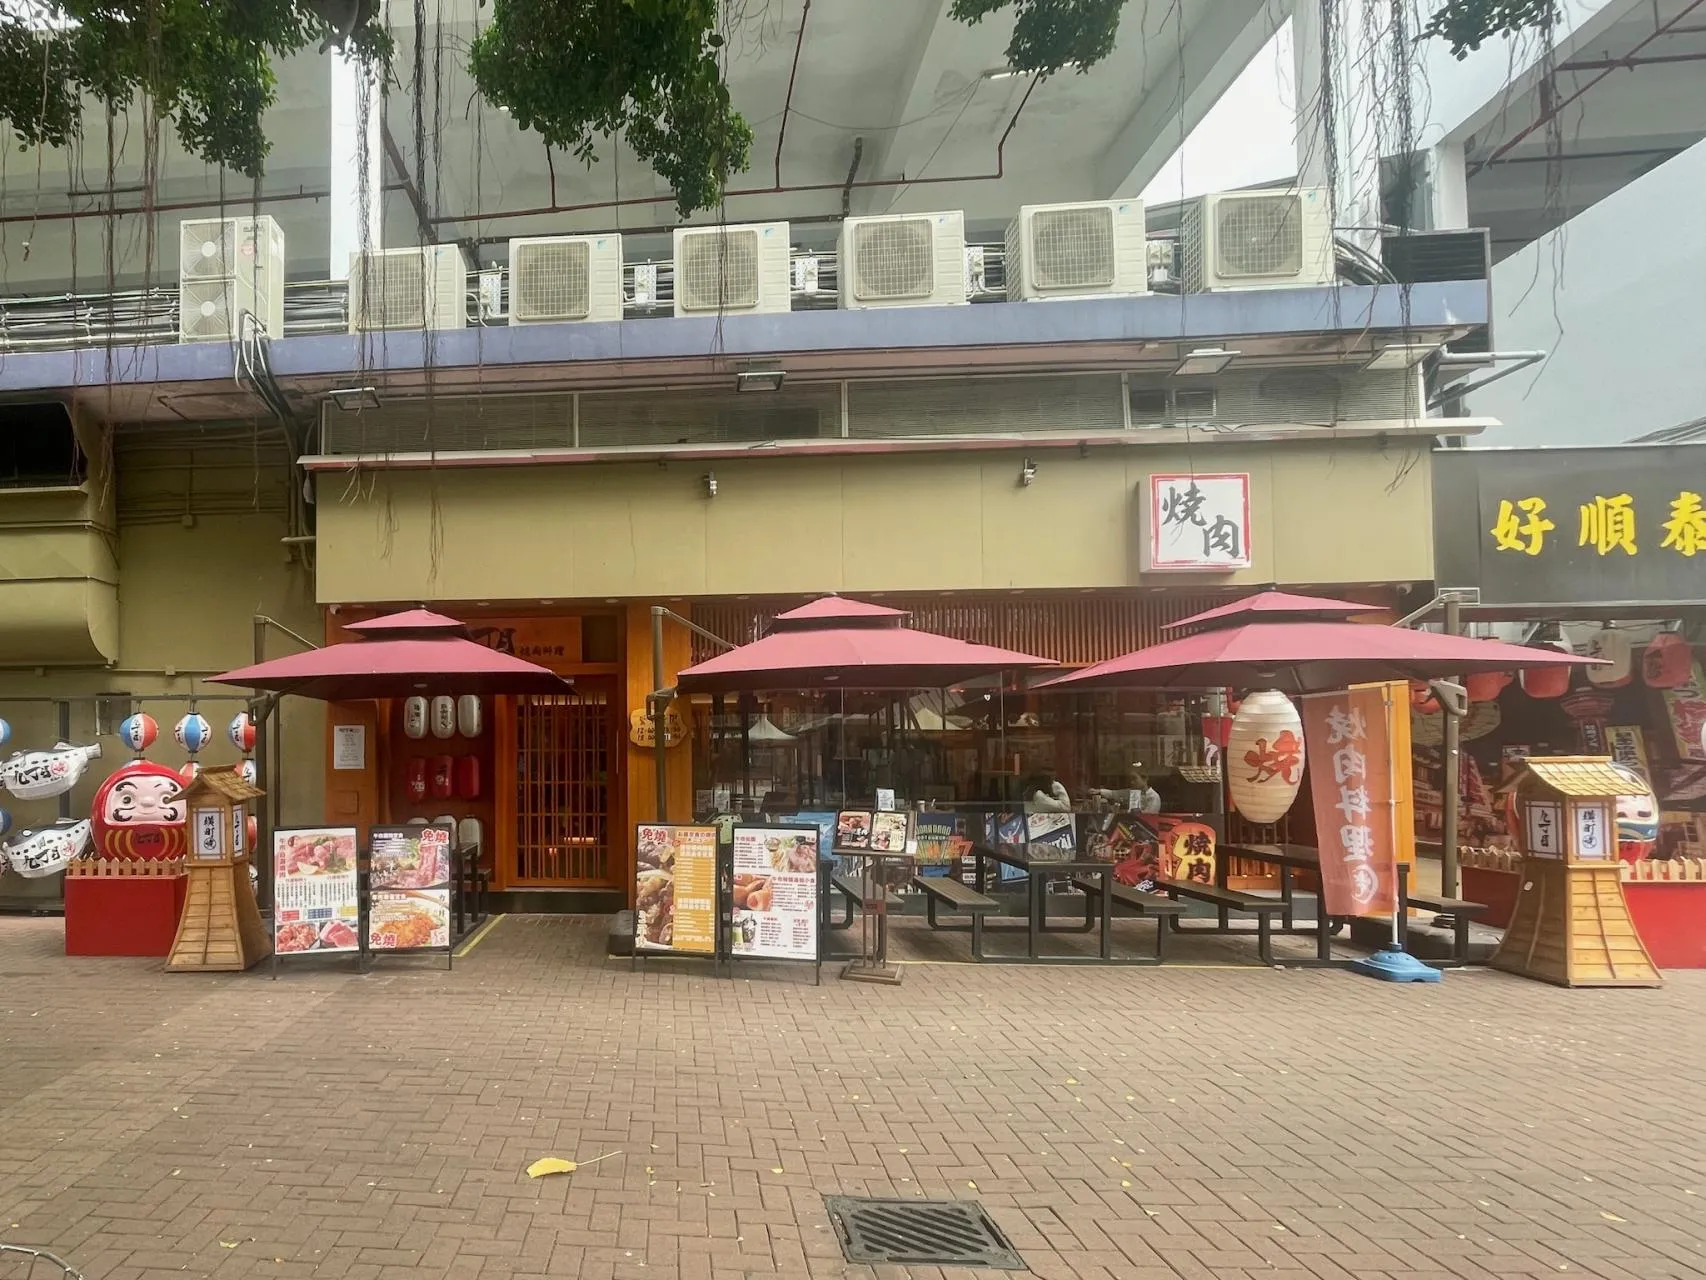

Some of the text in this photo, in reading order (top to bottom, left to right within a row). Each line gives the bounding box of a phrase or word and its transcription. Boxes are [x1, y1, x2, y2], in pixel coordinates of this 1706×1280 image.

[1489, 491, 1706, 557] 好順泰
[1538, 810, 1551, 847] 九丁目
